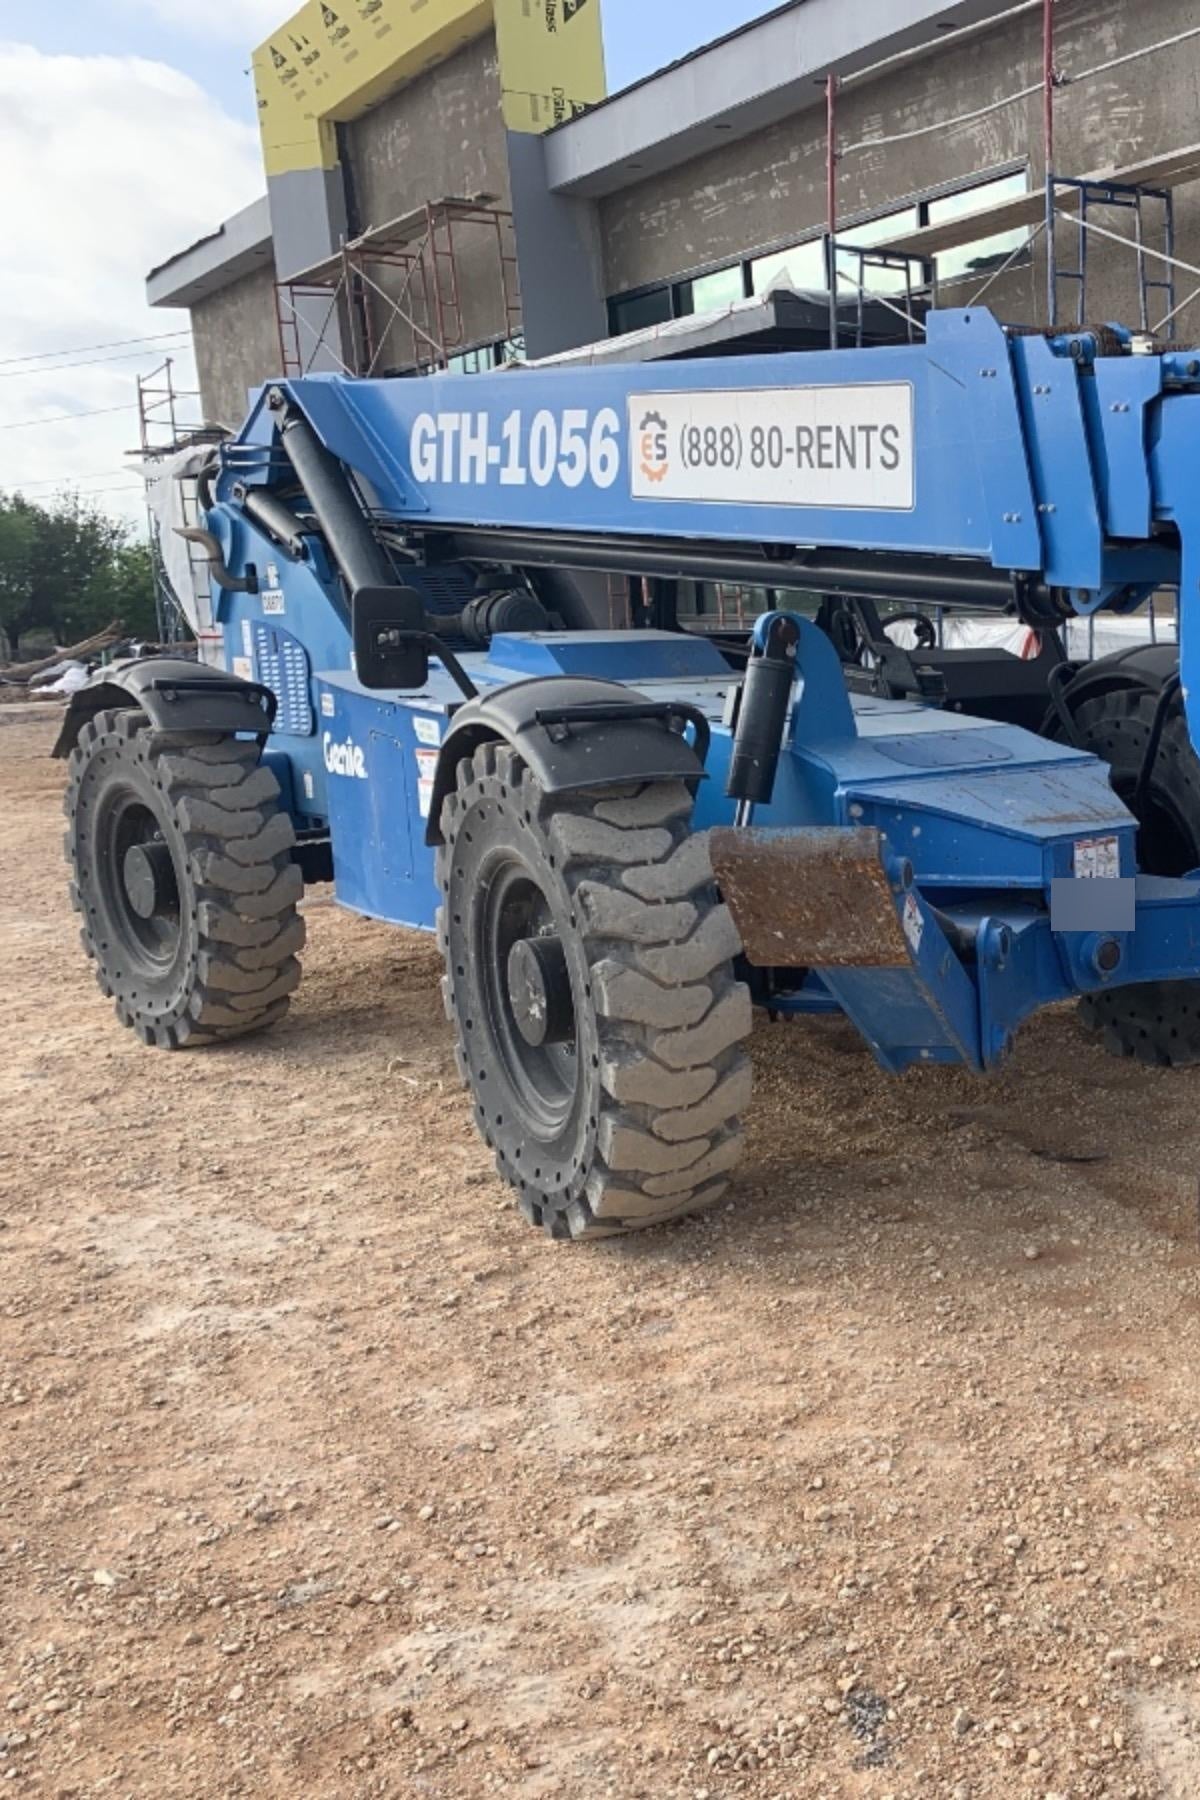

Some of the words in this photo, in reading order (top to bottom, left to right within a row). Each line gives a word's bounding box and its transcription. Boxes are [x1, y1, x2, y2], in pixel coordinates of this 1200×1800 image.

[409, 407, 621, 489] GTH-1056
[680, 423, 743, 471] (888)
[750, 424, 900, 471] 80-RENTS
[323, 731, 368, 778] Genie
